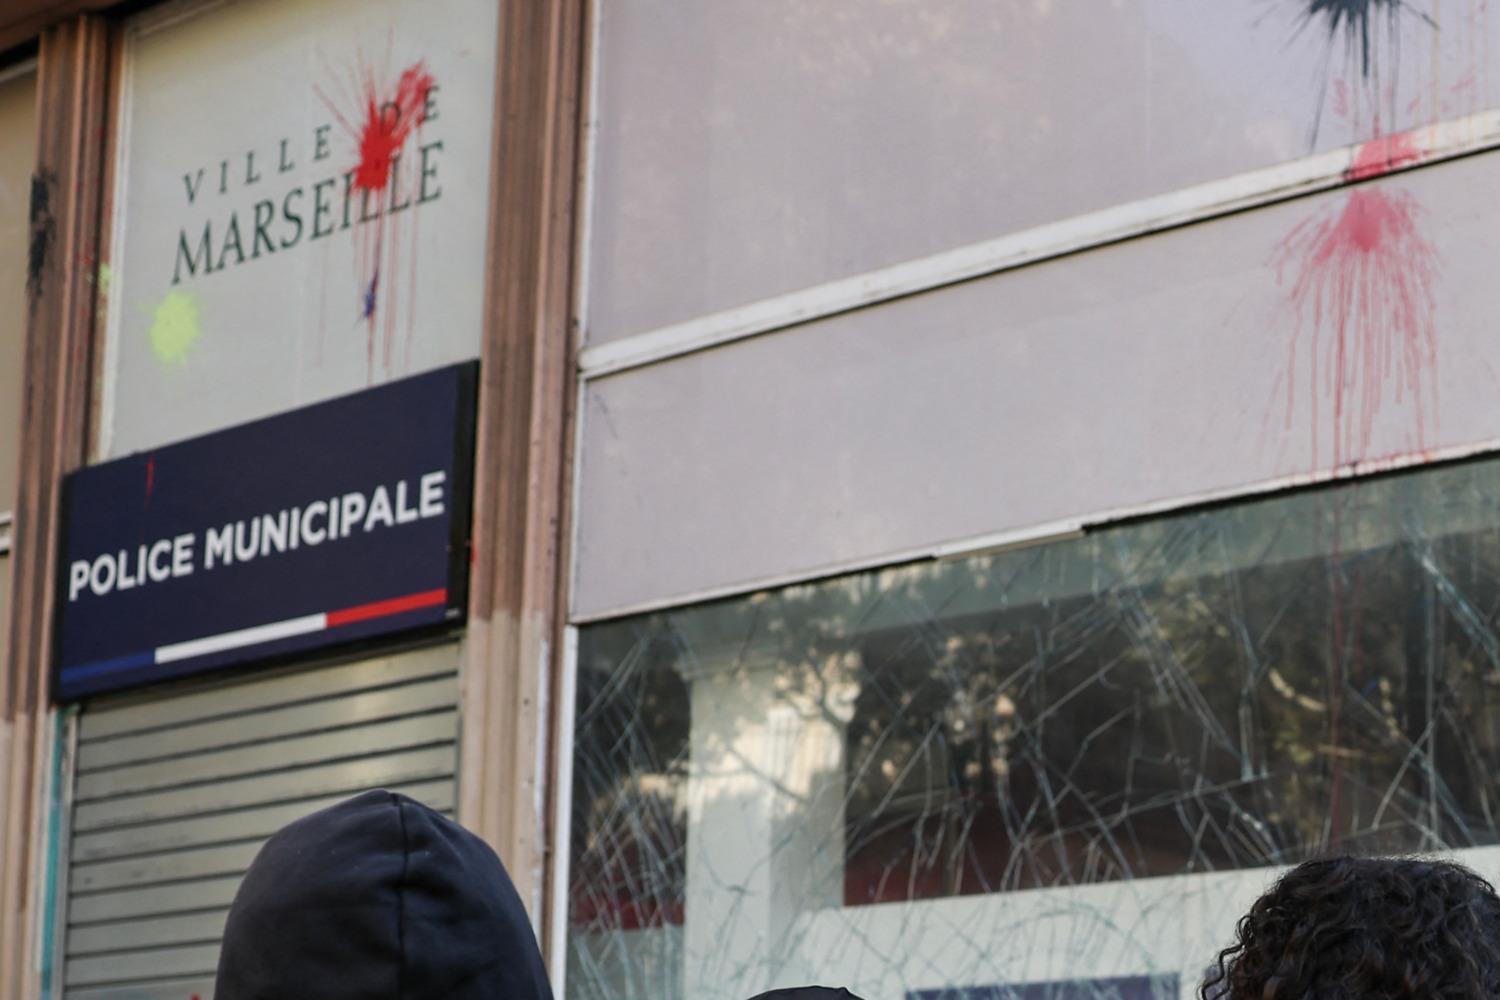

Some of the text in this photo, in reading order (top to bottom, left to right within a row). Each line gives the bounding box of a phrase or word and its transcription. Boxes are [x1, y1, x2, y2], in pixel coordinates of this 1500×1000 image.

[183, 85, 441, 204] VILLE DE
[171, 140, 444, 285] MARSEILLE
[69, 470, 447, 602] POLICE MUNICIPALE
